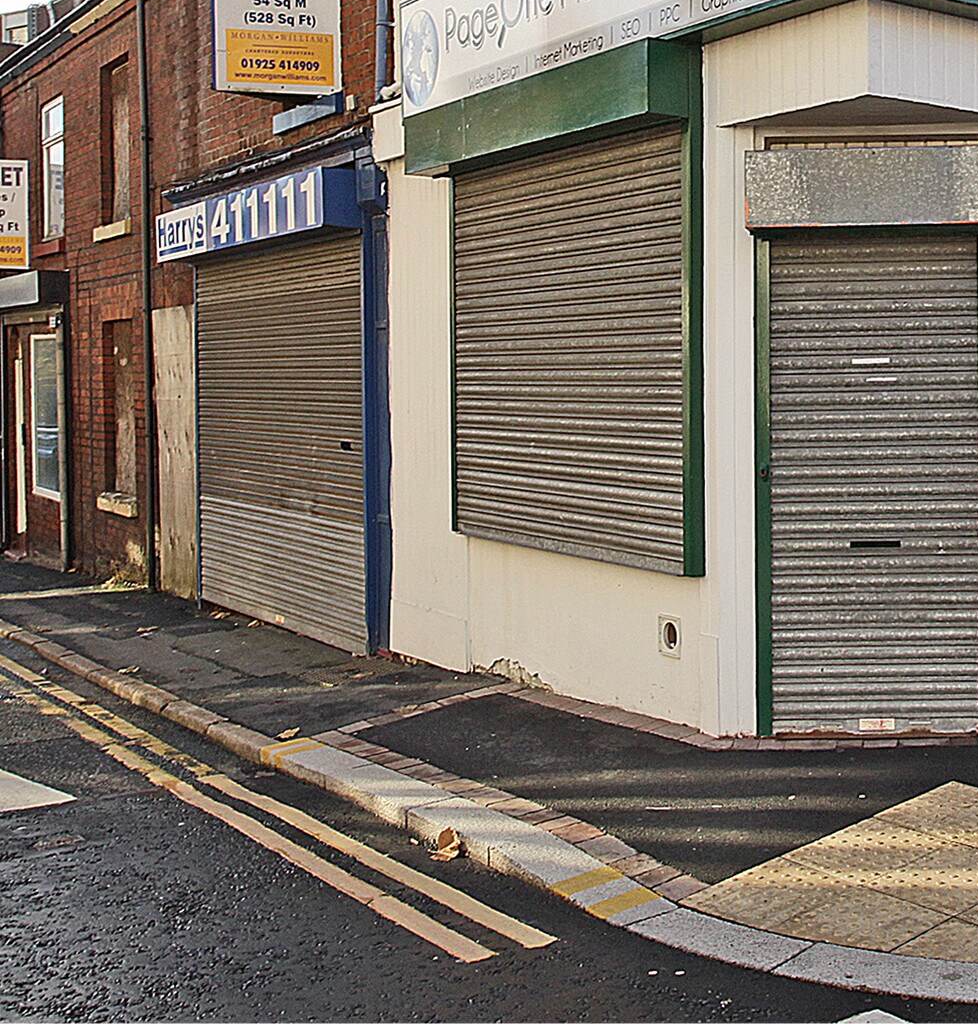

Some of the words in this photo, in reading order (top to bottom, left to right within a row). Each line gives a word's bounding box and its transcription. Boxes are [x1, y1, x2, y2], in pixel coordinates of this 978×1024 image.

[244, 12, 274, 24] (528
[278, 14, 295, 27] Sq
[299, 15, 316, 28] Ft)
[497, 64, 520, 83] Design
[534, 47, 562, 69] Internet
[563, 35, 604, 59] Marketing
[621, 17, 641, 41] SEO
[659, 3, 681, 27] PPC
[241, 58, 276, 69] 01925
[279, 60, 320, 72] 414909
[235, 72, 327, 82] www.morganwilliams.com
[0, 166, 23, 187] ET
[210, 171, 317, 244] 411111
[8, 221, 19, 232] Ft
